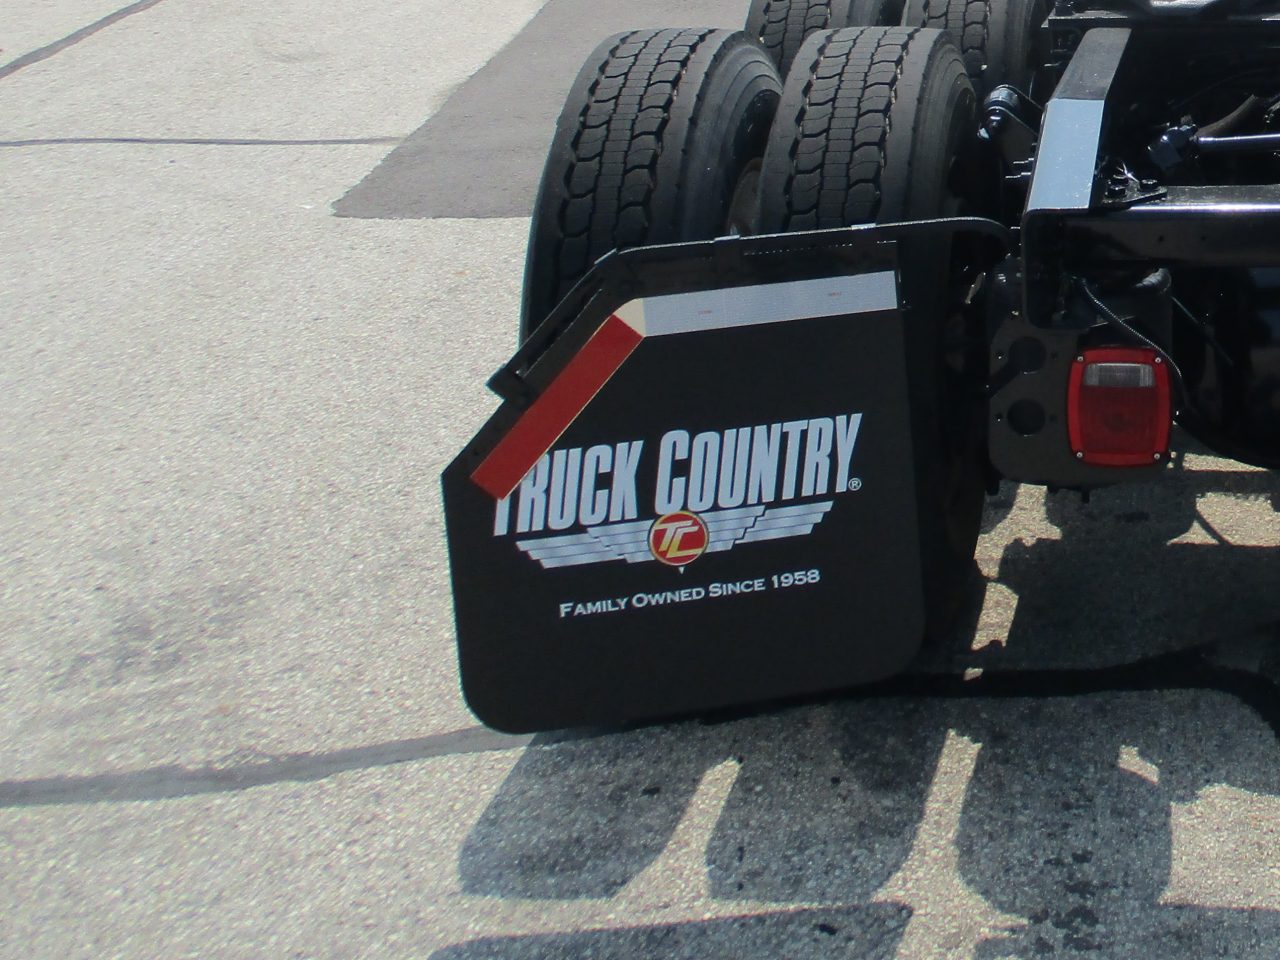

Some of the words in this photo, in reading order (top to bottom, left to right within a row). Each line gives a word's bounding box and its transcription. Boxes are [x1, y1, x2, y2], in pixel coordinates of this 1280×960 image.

[654, 413, 863, 516] COUNTRY
[559, 595, 628, 619] FAMILY
[632, 585, 706, 609] OWNED
[708, 577, 766, 599] SINCE
[771, 568, 821, 591] 1958
